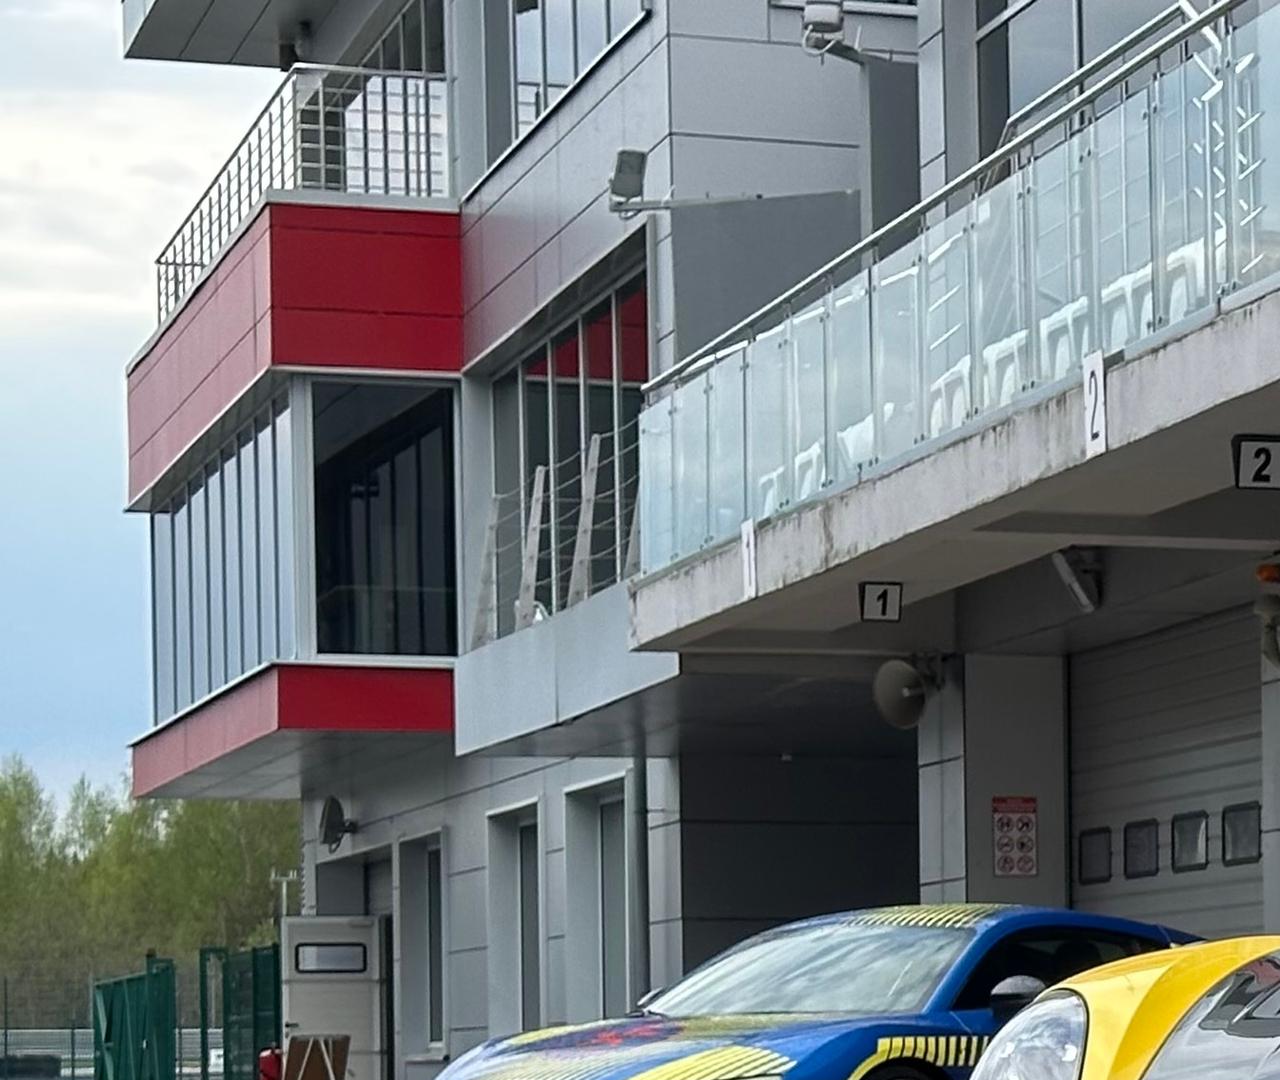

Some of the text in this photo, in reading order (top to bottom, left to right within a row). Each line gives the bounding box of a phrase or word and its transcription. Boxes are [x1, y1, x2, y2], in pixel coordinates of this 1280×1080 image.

[1089, 369, 1100, 441] 2
[1251, 446, 1271, 483] 2
[876, 588, 888, 616] 1
